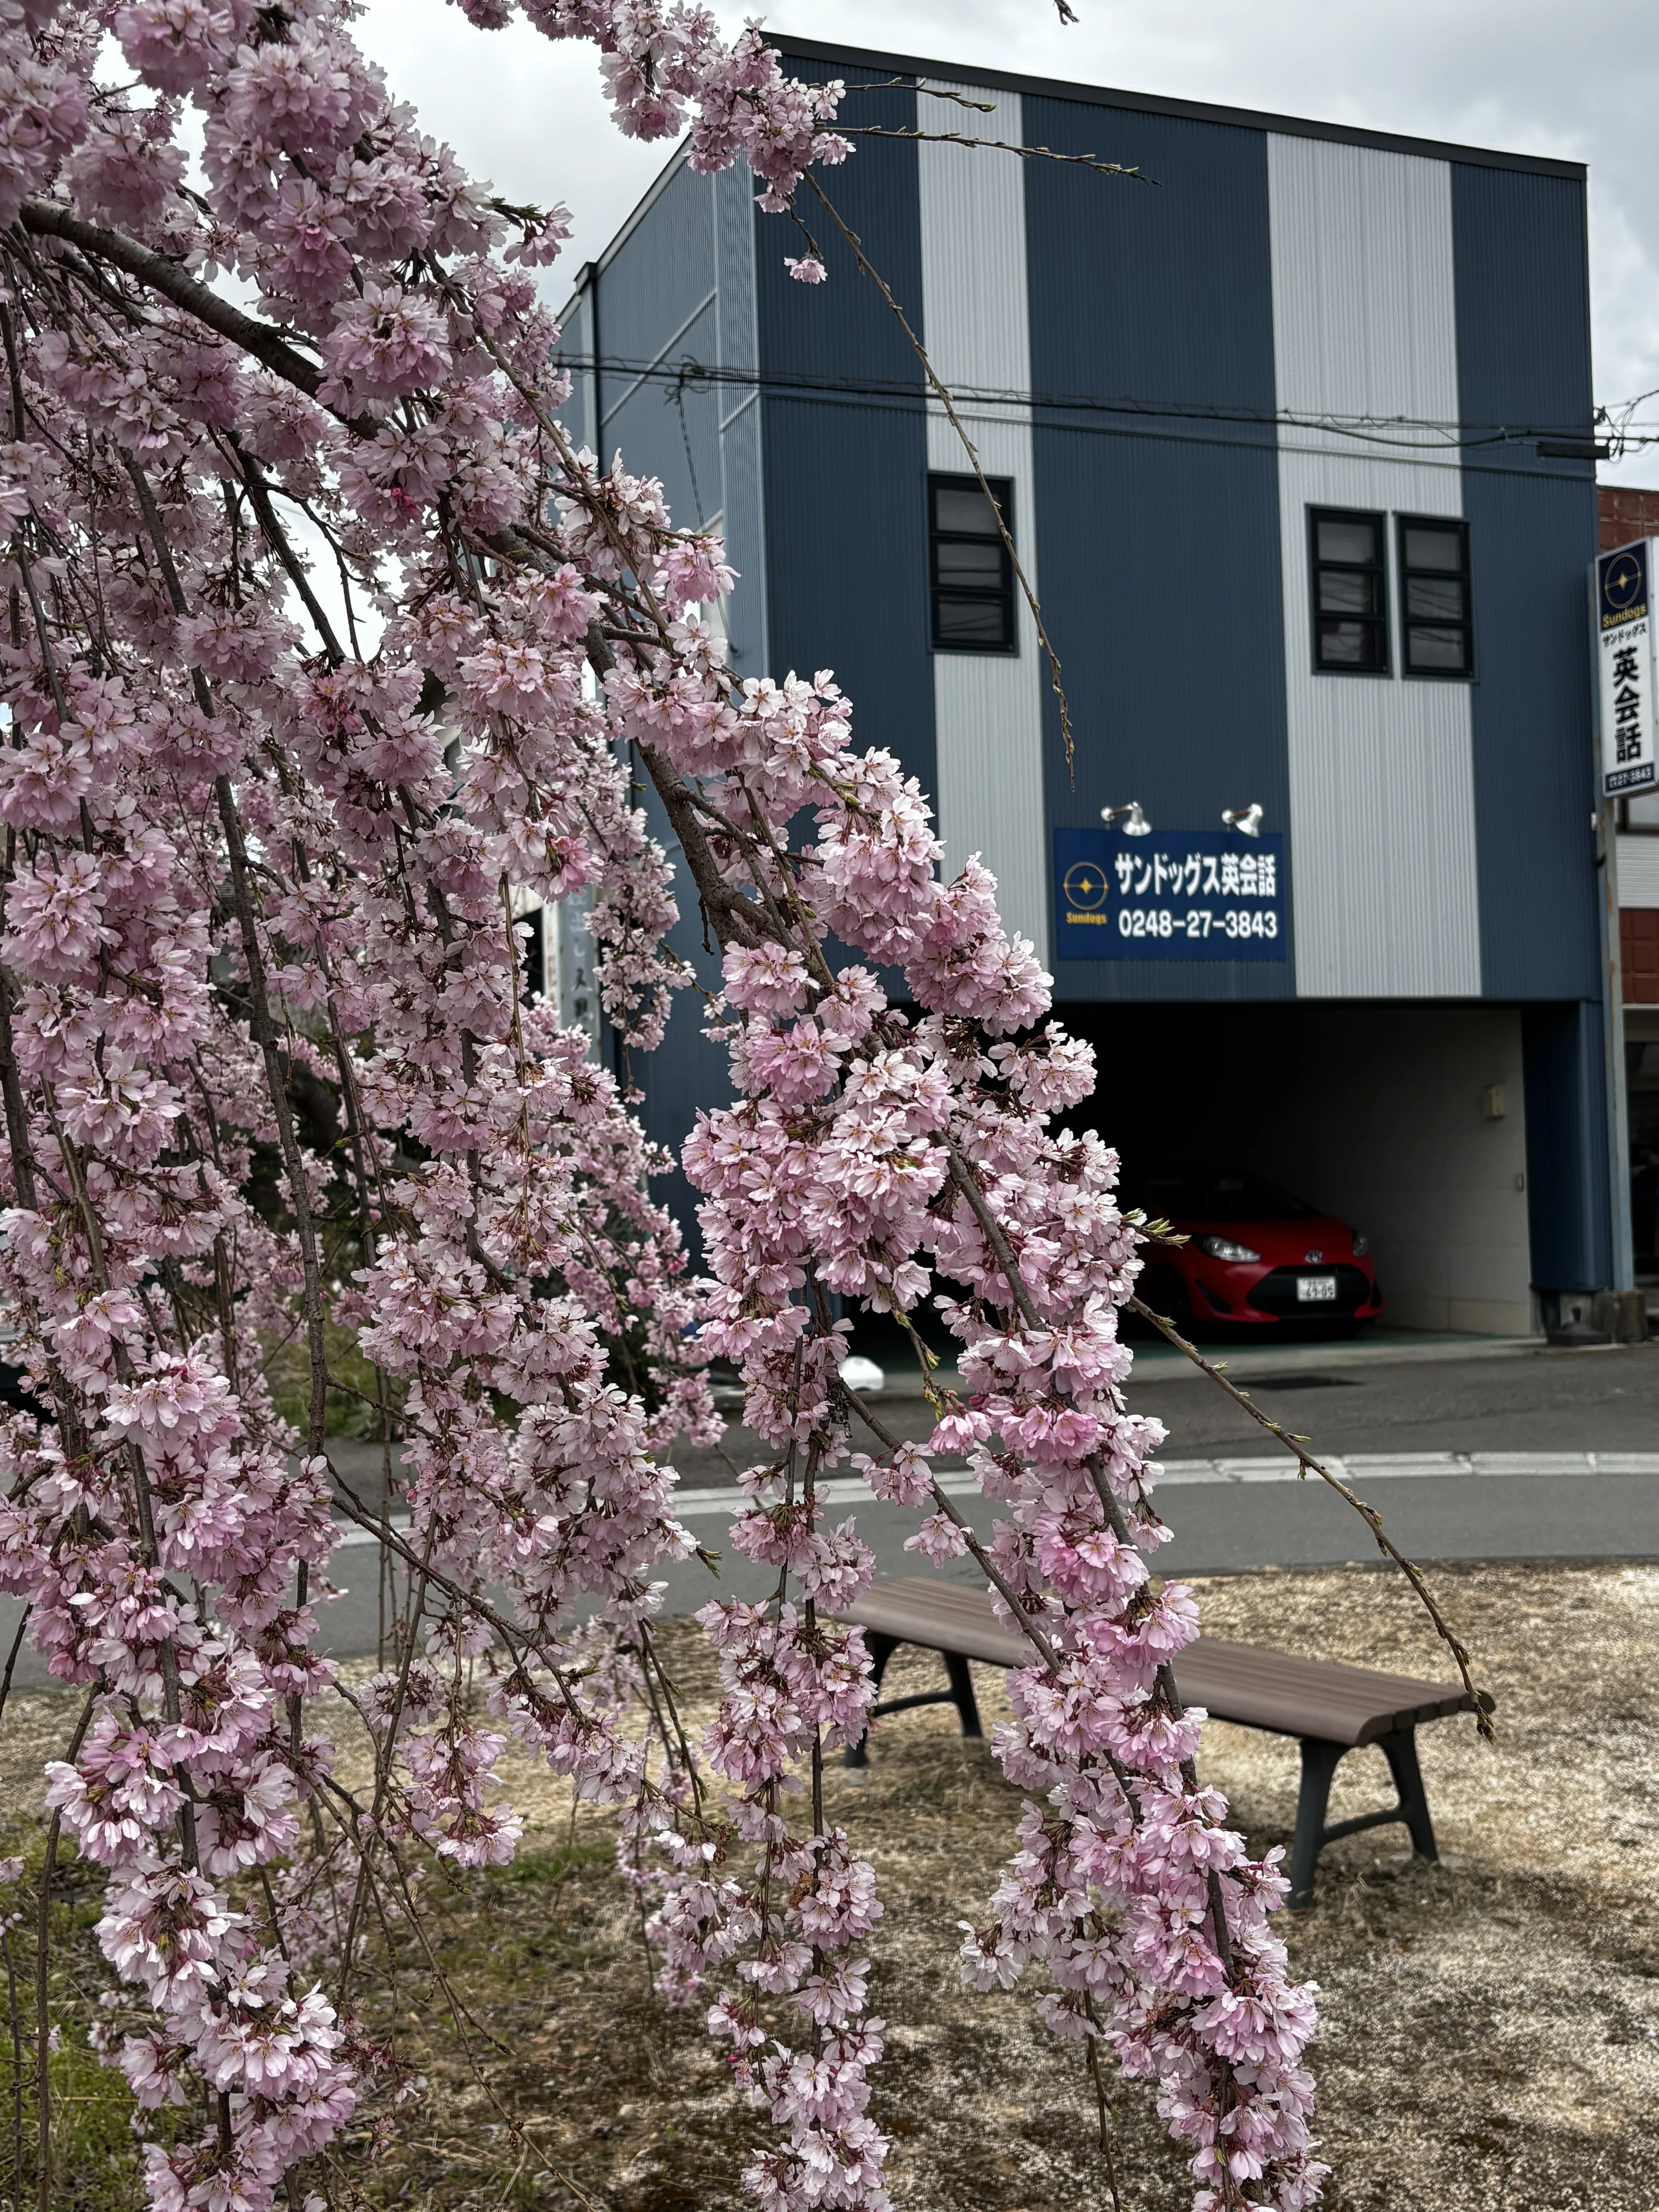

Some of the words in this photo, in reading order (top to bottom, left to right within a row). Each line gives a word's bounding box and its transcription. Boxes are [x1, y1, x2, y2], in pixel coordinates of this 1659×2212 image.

[1603, 604, 1646, 628] Sundogs
[1602, 622, 1647, 647] サンドッグス
[1613, 645, 1642, 763] 英会話
[1115, 852, 1276, 896] サンドッグス英会話
[1066, 911, 1107, 925] Sundogs
[1119, 909, 1277, 938] 0248-27-3843
